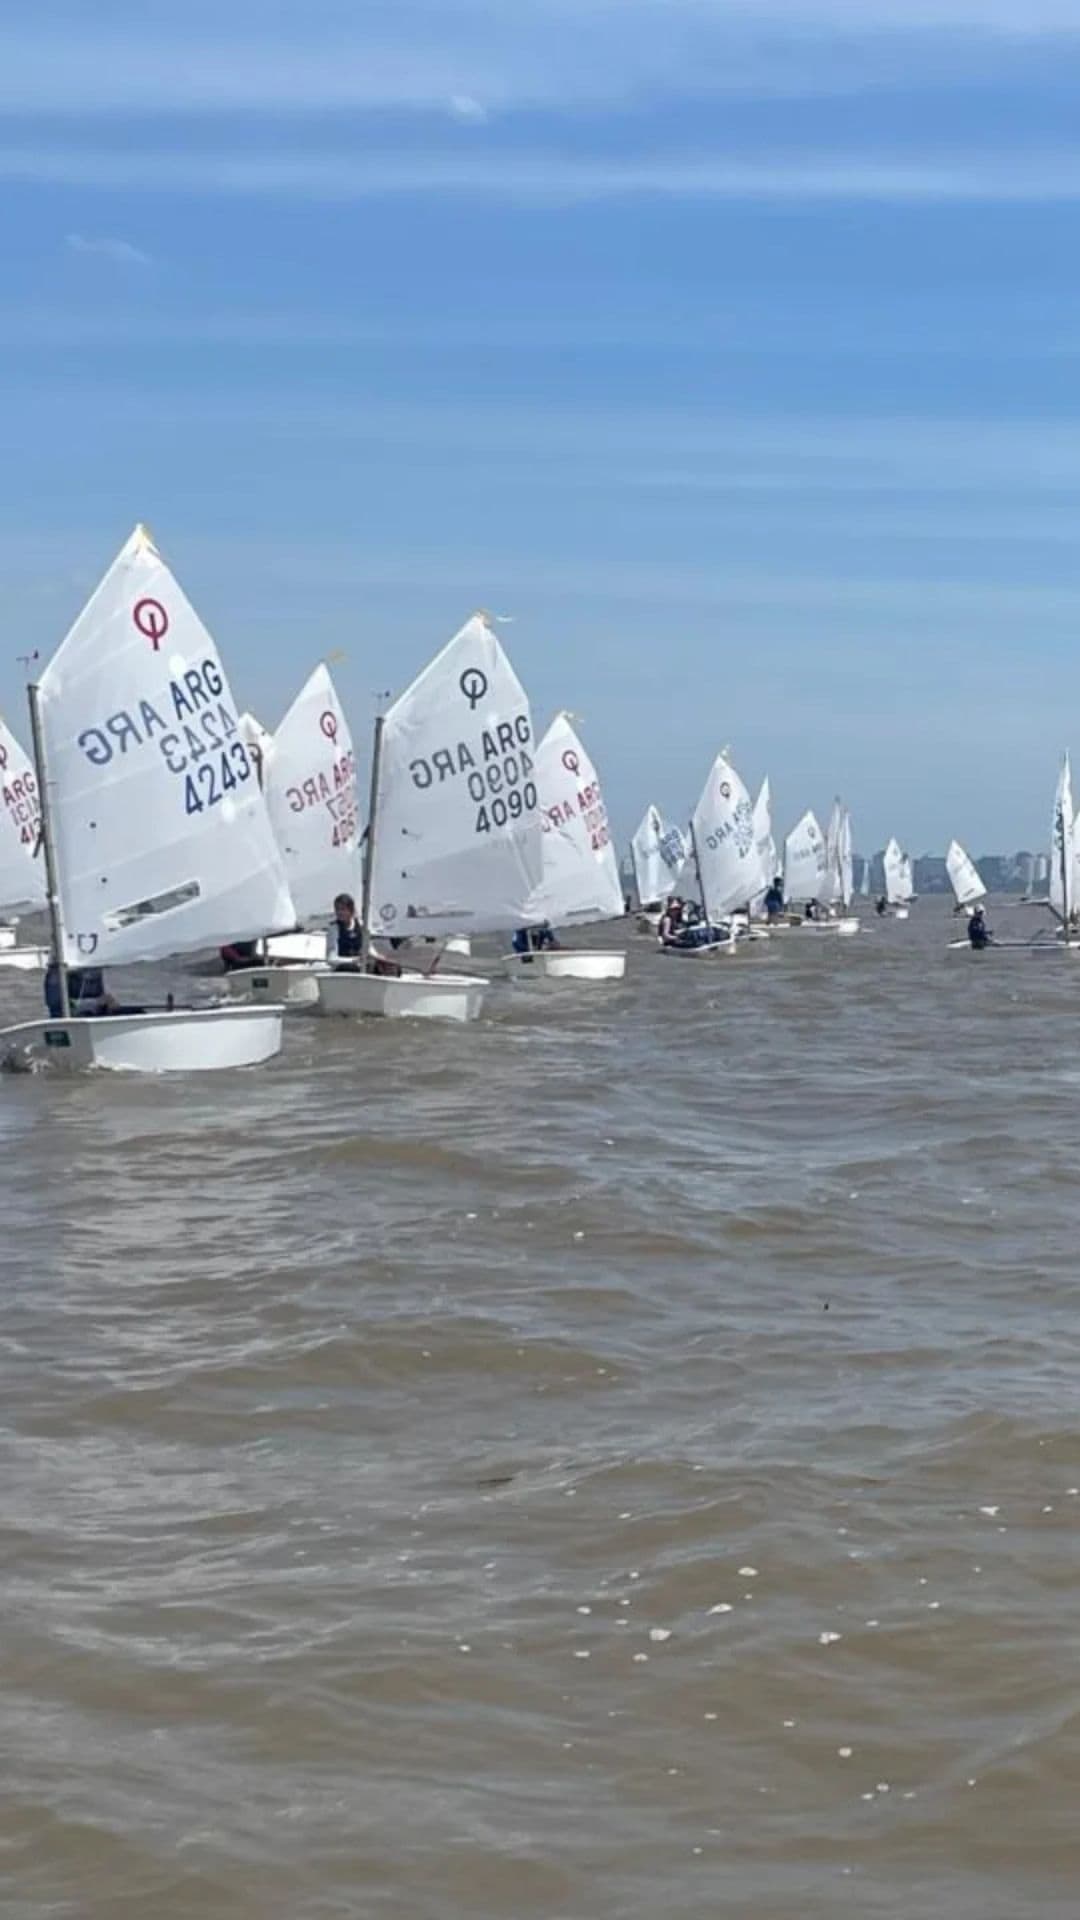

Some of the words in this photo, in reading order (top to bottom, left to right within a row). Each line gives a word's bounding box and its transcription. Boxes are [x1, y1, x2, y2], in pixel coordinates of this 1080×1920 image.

[170, 659, 223, 721] ARG
[482, 714, 530, 761] ARG
[3, 771, 36, 807] ARG
[185, 742, 250, 815] 4243
[476, 782, 537, 833] 4090
